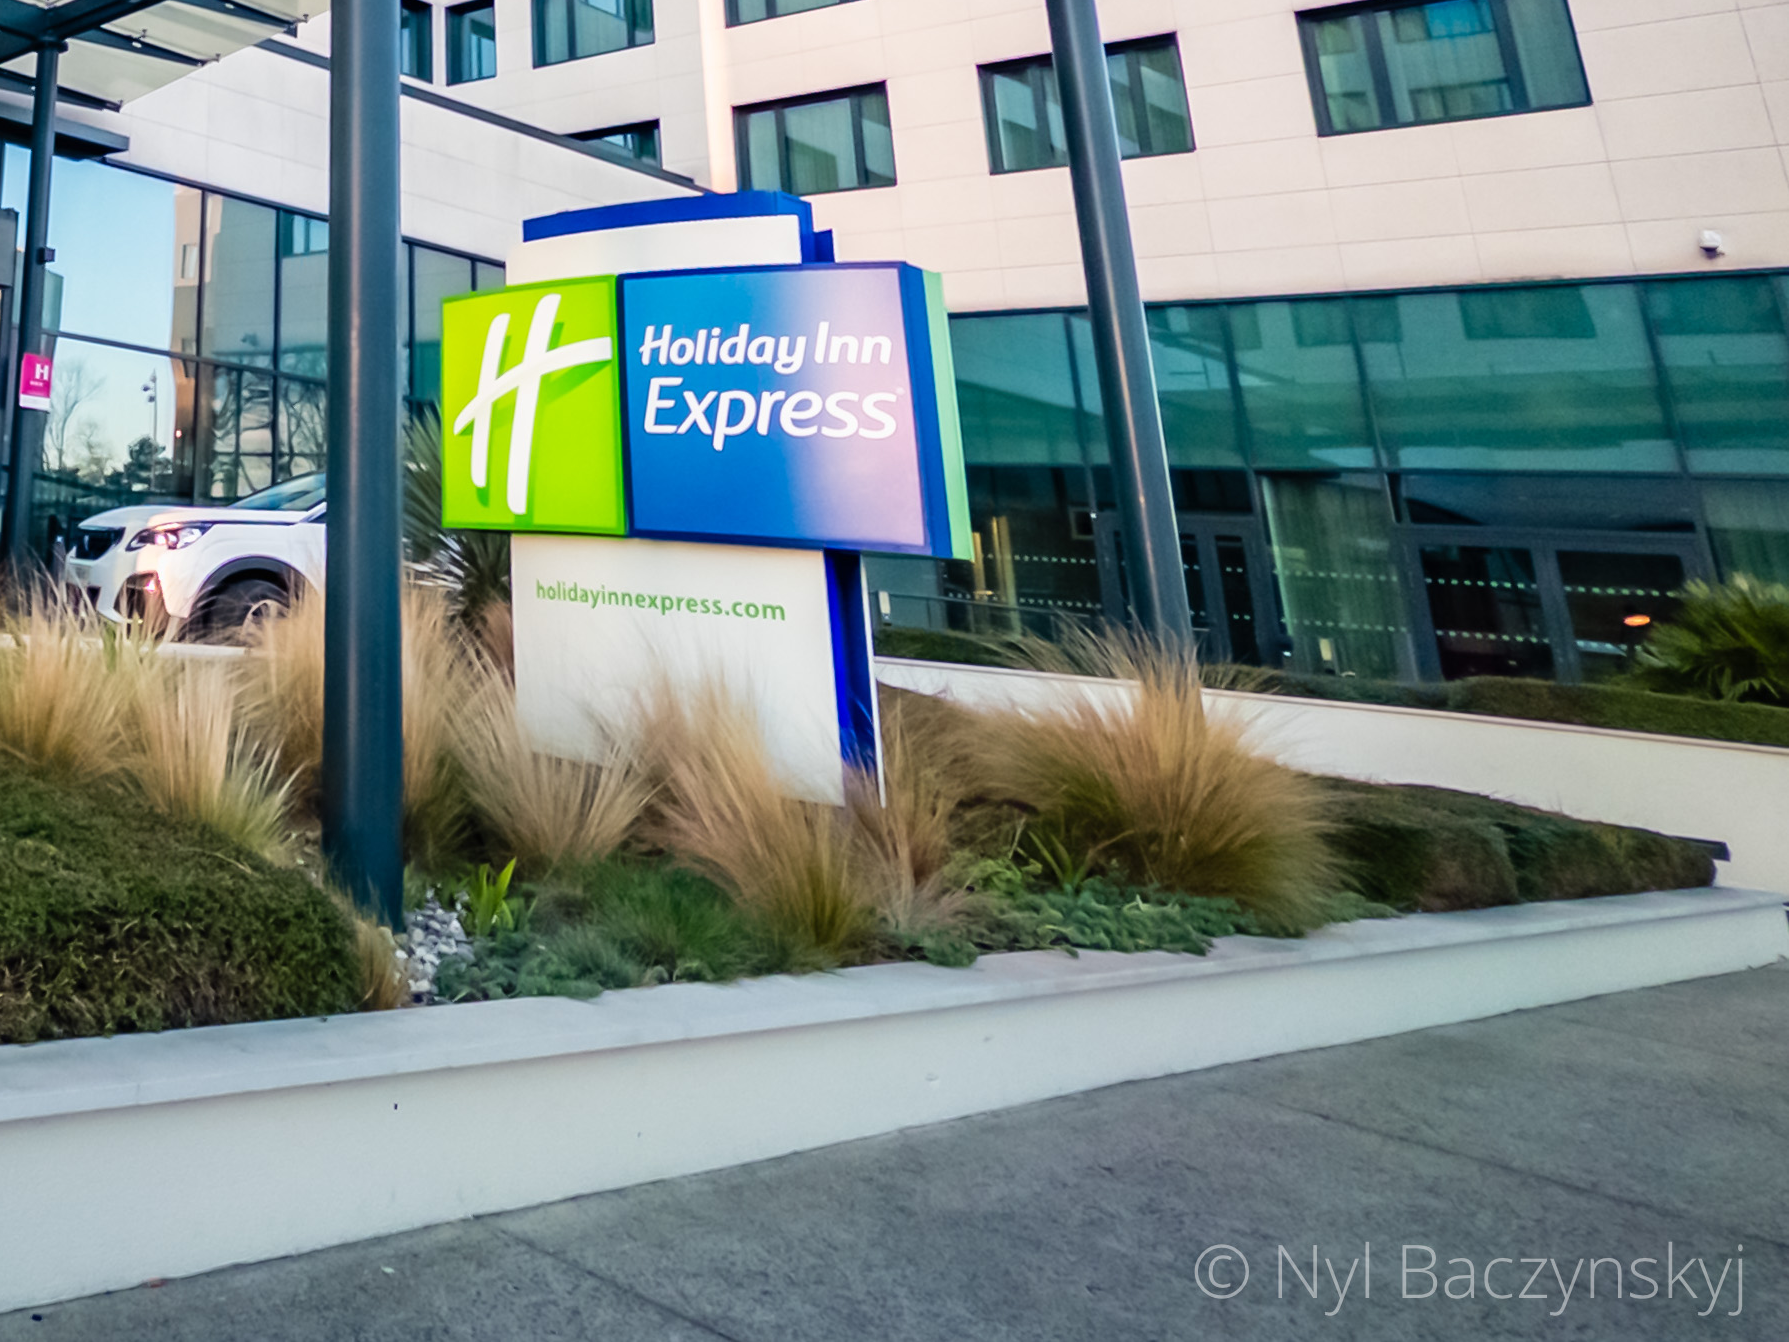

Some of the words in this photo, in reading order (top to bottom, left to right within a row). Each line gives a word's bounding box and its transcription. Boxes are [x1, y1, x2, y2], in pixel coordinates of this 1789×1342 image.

[639, 323, 804, 374] Holiday
[815, 321, 892, 364] Inn
[643, 376, 902, 451] Express
[536, 579, 786, 621] holidayinnexpress.com
